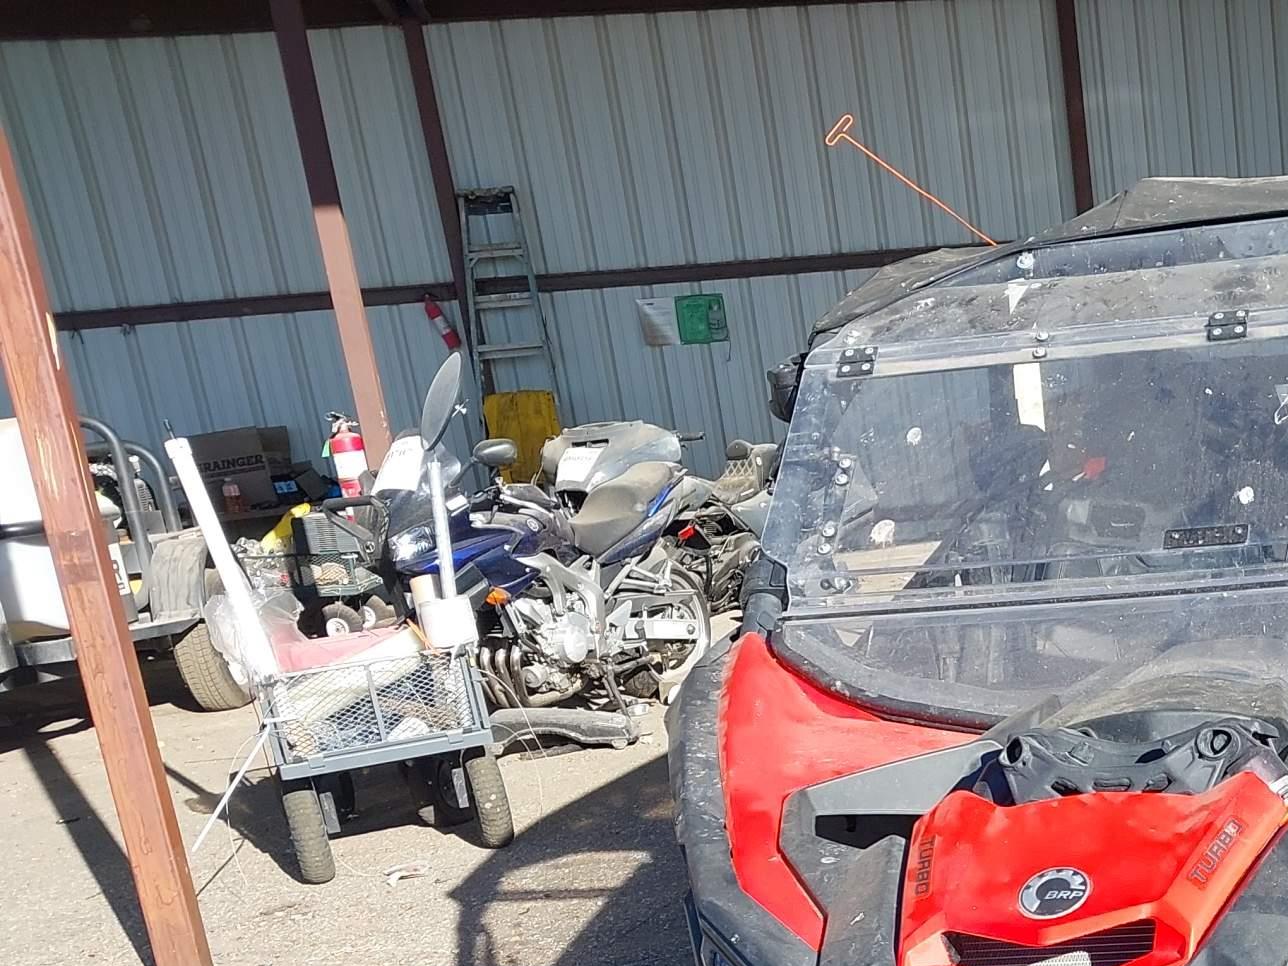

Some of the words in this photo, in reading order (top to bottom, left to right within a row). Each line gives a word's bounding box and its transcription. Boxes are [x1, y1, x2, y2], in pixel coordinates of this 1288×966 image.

[915, 835, 937, 897] TURBO
[1189, 818, 1243, 885] TURBO
[1043, 889, 1085, 900] BRP
